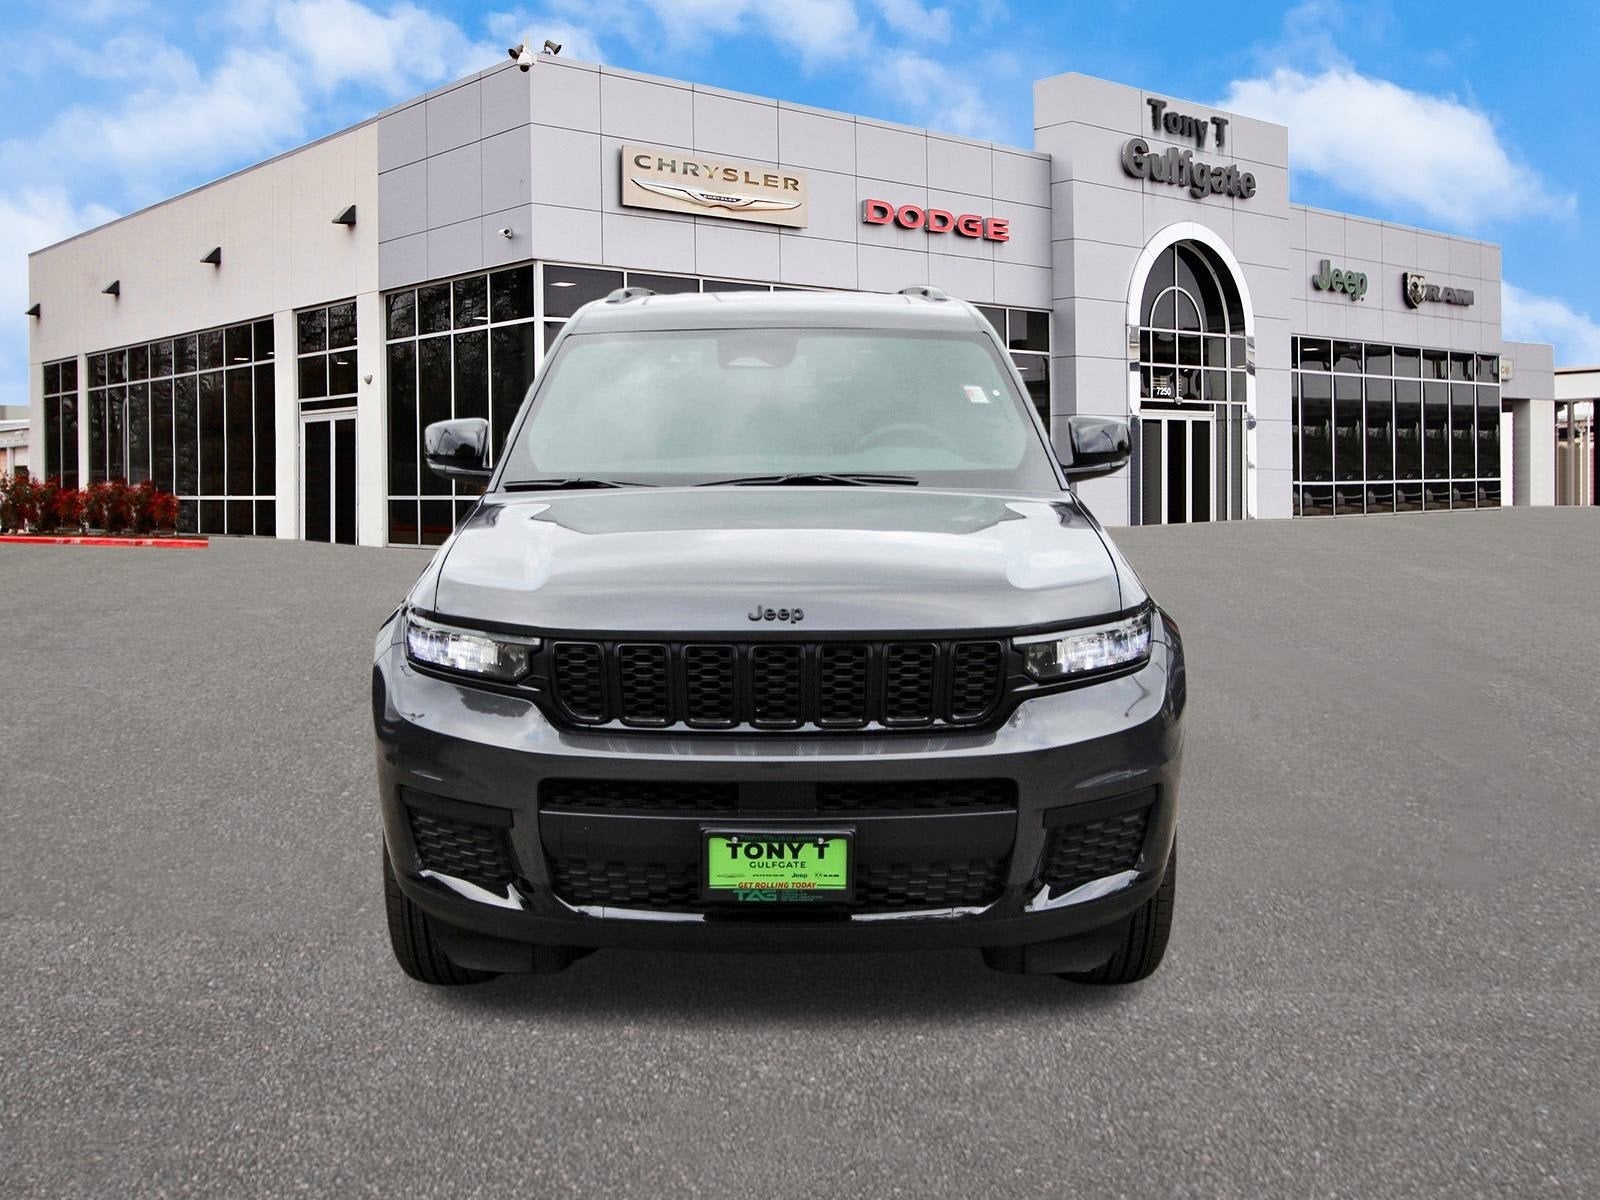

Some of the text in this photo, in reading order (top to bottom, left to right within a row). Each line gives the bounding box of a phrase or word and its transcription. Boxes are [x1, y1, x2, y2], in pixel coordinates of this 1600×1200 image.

[1147, 98, 1229, 148] Tony T
[634, 154, 799, 191] CHRYSLER
[1121, 138, 1256, 199] Gulfgate
[862, 199, 1009, 242] DODGE
[1312, 259, 1367, 301] Jeep
[1425, 284, 1474, 306] RAM
[748, 605, 804, 624] Jeep
[726, 842, 830, 860] TONY T
[749, 861, 807, 869] GULFGATE
[738, 881, 817, 889] GET ROLLING TODAY
